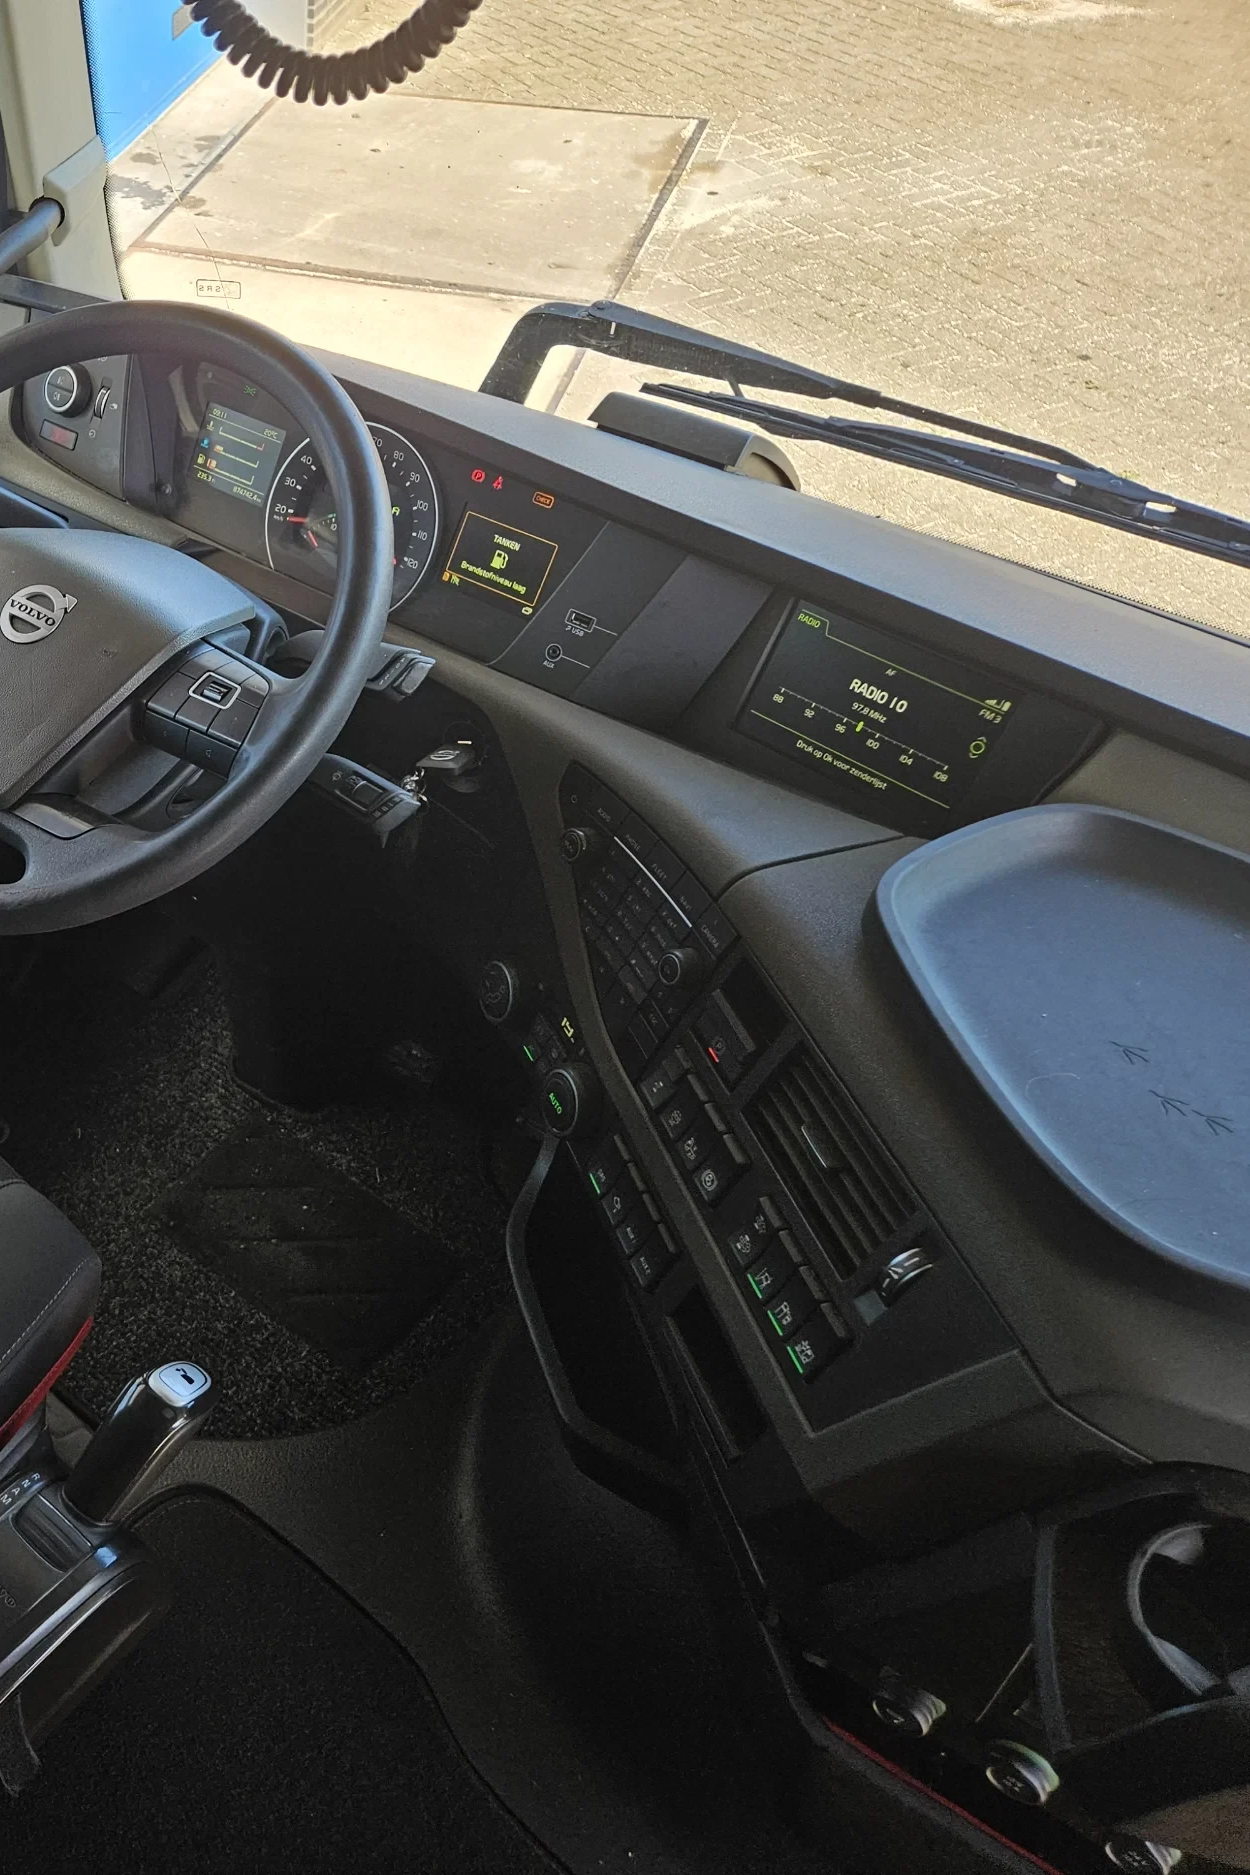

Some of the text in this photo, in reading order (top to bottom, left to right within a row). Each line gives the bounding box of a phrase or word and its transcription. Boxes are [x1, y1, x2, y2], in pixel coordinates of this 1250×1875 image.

[212, 408, 227, 419] 09:11
[300, 454, 313, 465] 40
[393, 450, 404, 461] 80
[284, 476, 296, 487] 30
[409, 471, 421, 483] 90
[416, 499, 429, 511] 100
[535, 494, 551, 505] CHECK
[274, 503, 287, 514] 20
[417, 530, 428, 541] 110
[493, 533, 521, 551] TANKEN
[406, 558, 419, 569] 120
[460, 560, 513, 588] Brandstofniveau
[512, 581, 527, 595] laag
[10, 598, 56, 627] VOLVO
[798, 612, 821, 629] RADIO
[571, 627, 584, 637] USB
[542, 660, 555, 669] AUX
[885, 668, 897, 677] AF
[772, 693, 784, 704] 88
[849, 678, 908, 713] RADIO 10
[804, 708, 815, 719] 92
[868, 708, 888, 724] MHz
[979, 708, 1002, 724] FM 3
[834, 723, 846, 734] 96
[866, 739, 880, 750] 100
[796, 738, 814, 755] Druk
[813, 748, 825, 761] op
[833, 757, 851, 772] voor
[849, 765, 888, 791] zenderlijst
[899, 754, 914, 766] 104
[933, 770, 948, 782] 108
[549, 1092, 563, 1115] AUTO
[31, 1472, 40, 1481] R
[11, 1487, 21, 1496] A
[1, 1494, 12, 1505] M
